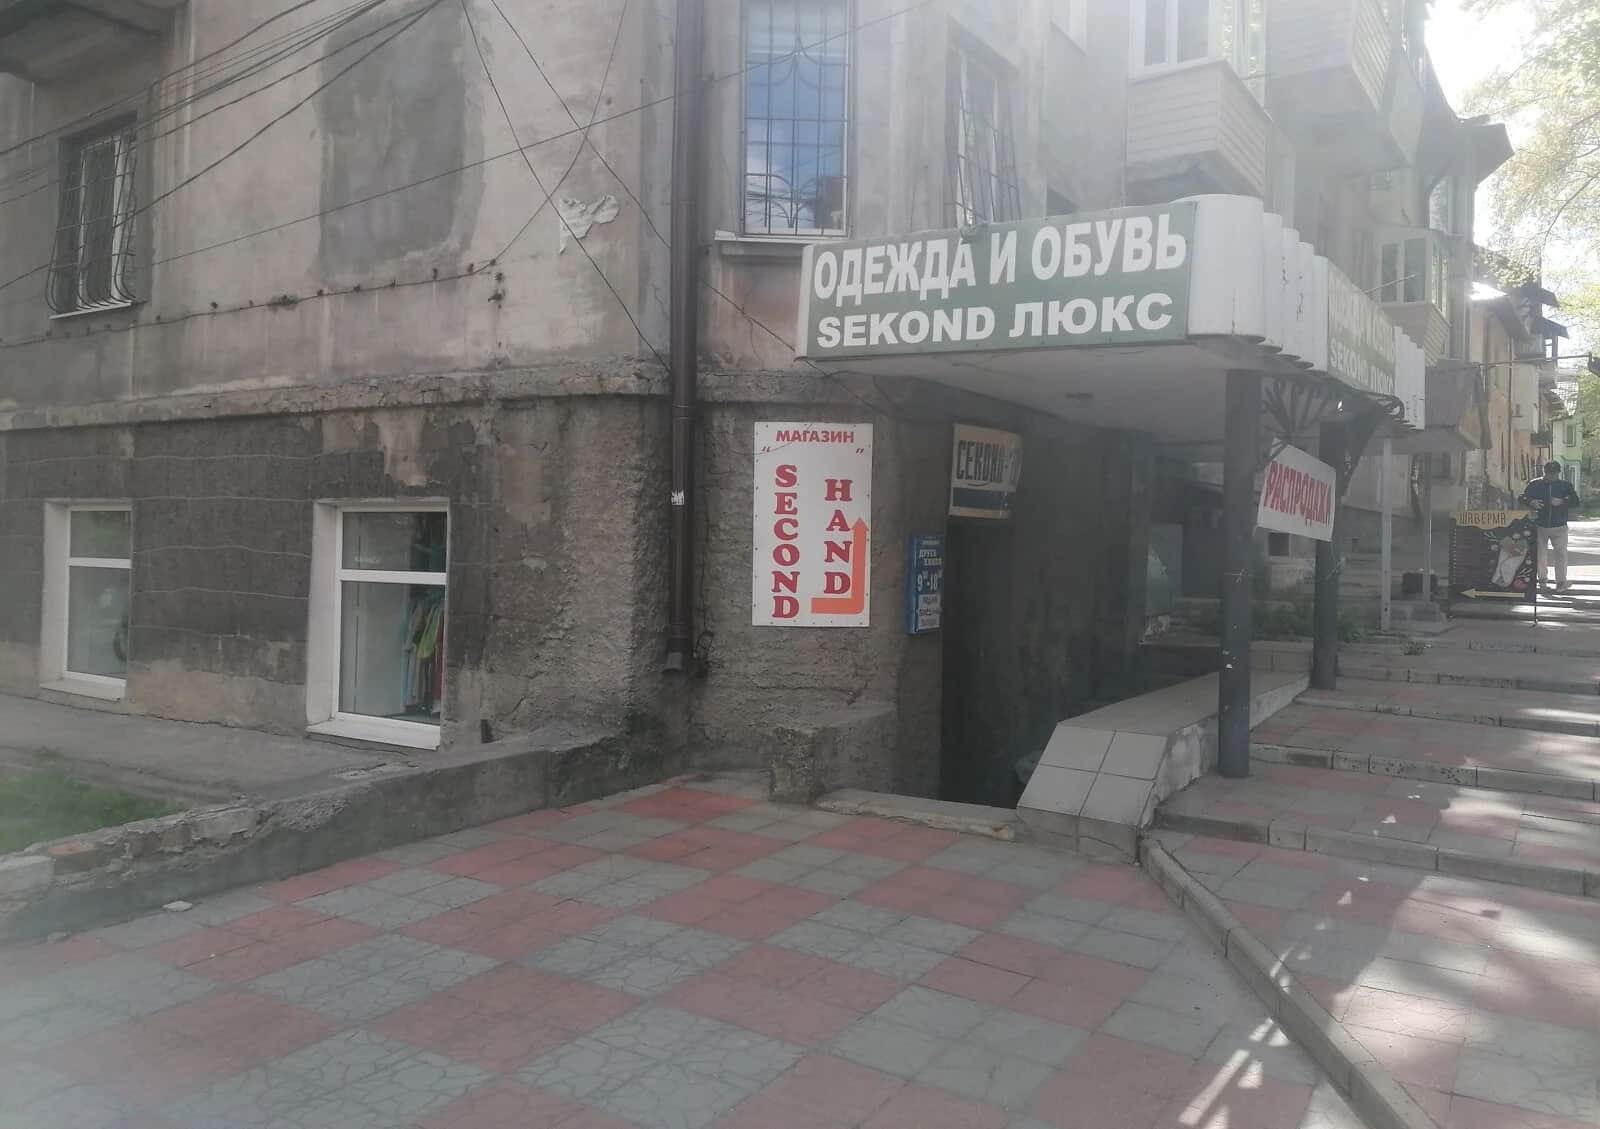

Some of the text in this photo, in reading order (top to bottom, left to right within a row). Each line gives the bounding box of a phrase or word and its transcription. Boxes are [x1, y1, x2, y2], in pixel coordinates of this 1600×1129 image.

[814, 213, 1187, 307] ОДЕЖДА И ОБУВЬ
[817, 293, 1173, 349] SEKOND ЛЮКС
[775, 430, 854, 444] МАГАЗИН
